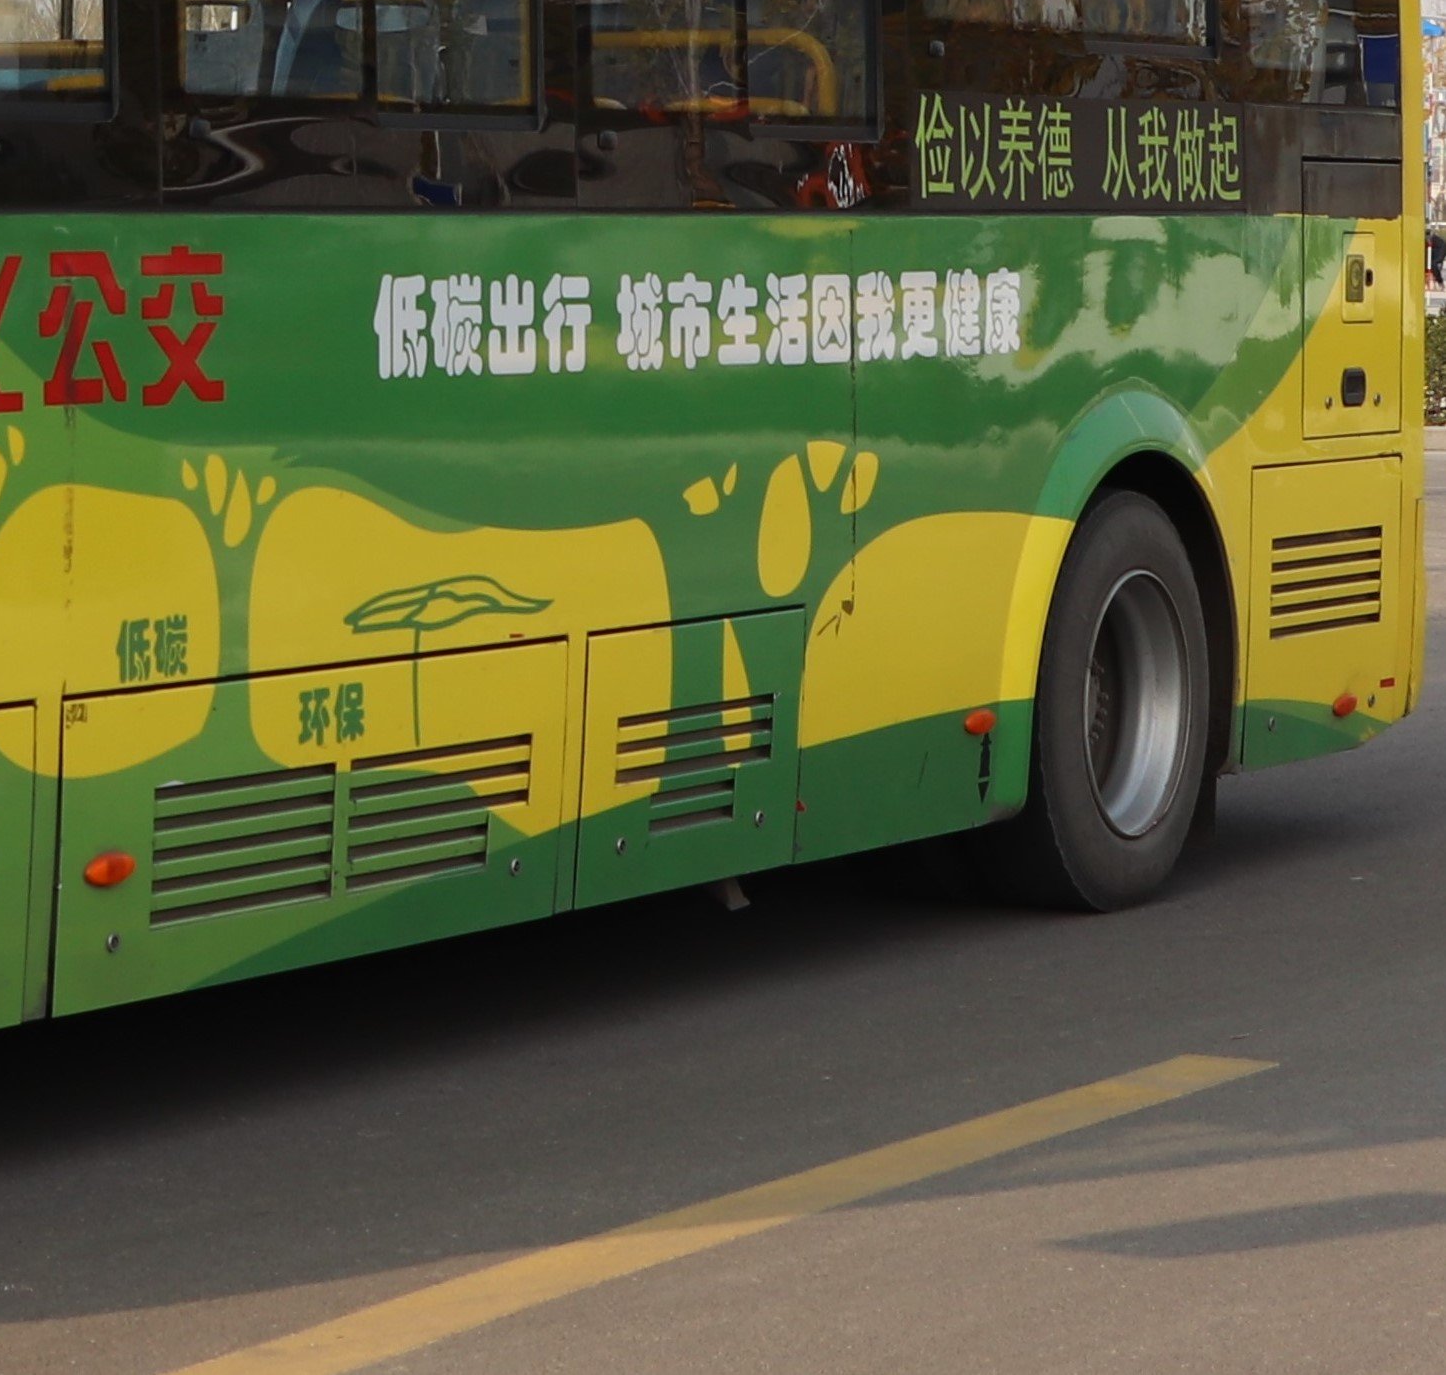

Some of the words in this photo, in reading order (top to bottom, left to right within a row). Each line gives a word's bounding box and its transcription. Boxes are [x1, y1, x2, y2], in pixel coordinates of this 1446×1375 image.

[915, 92, 1074, 202] 俭以养德
[1102, 105, 1242, 202] 从我做起
[373, 273, 593, 380] 低碳出行
[616, 267, 1022, 371] 城市生活因我更健康
[116, 614, 189, 683] 低碳
[298, 682, 365, 745] 环保
